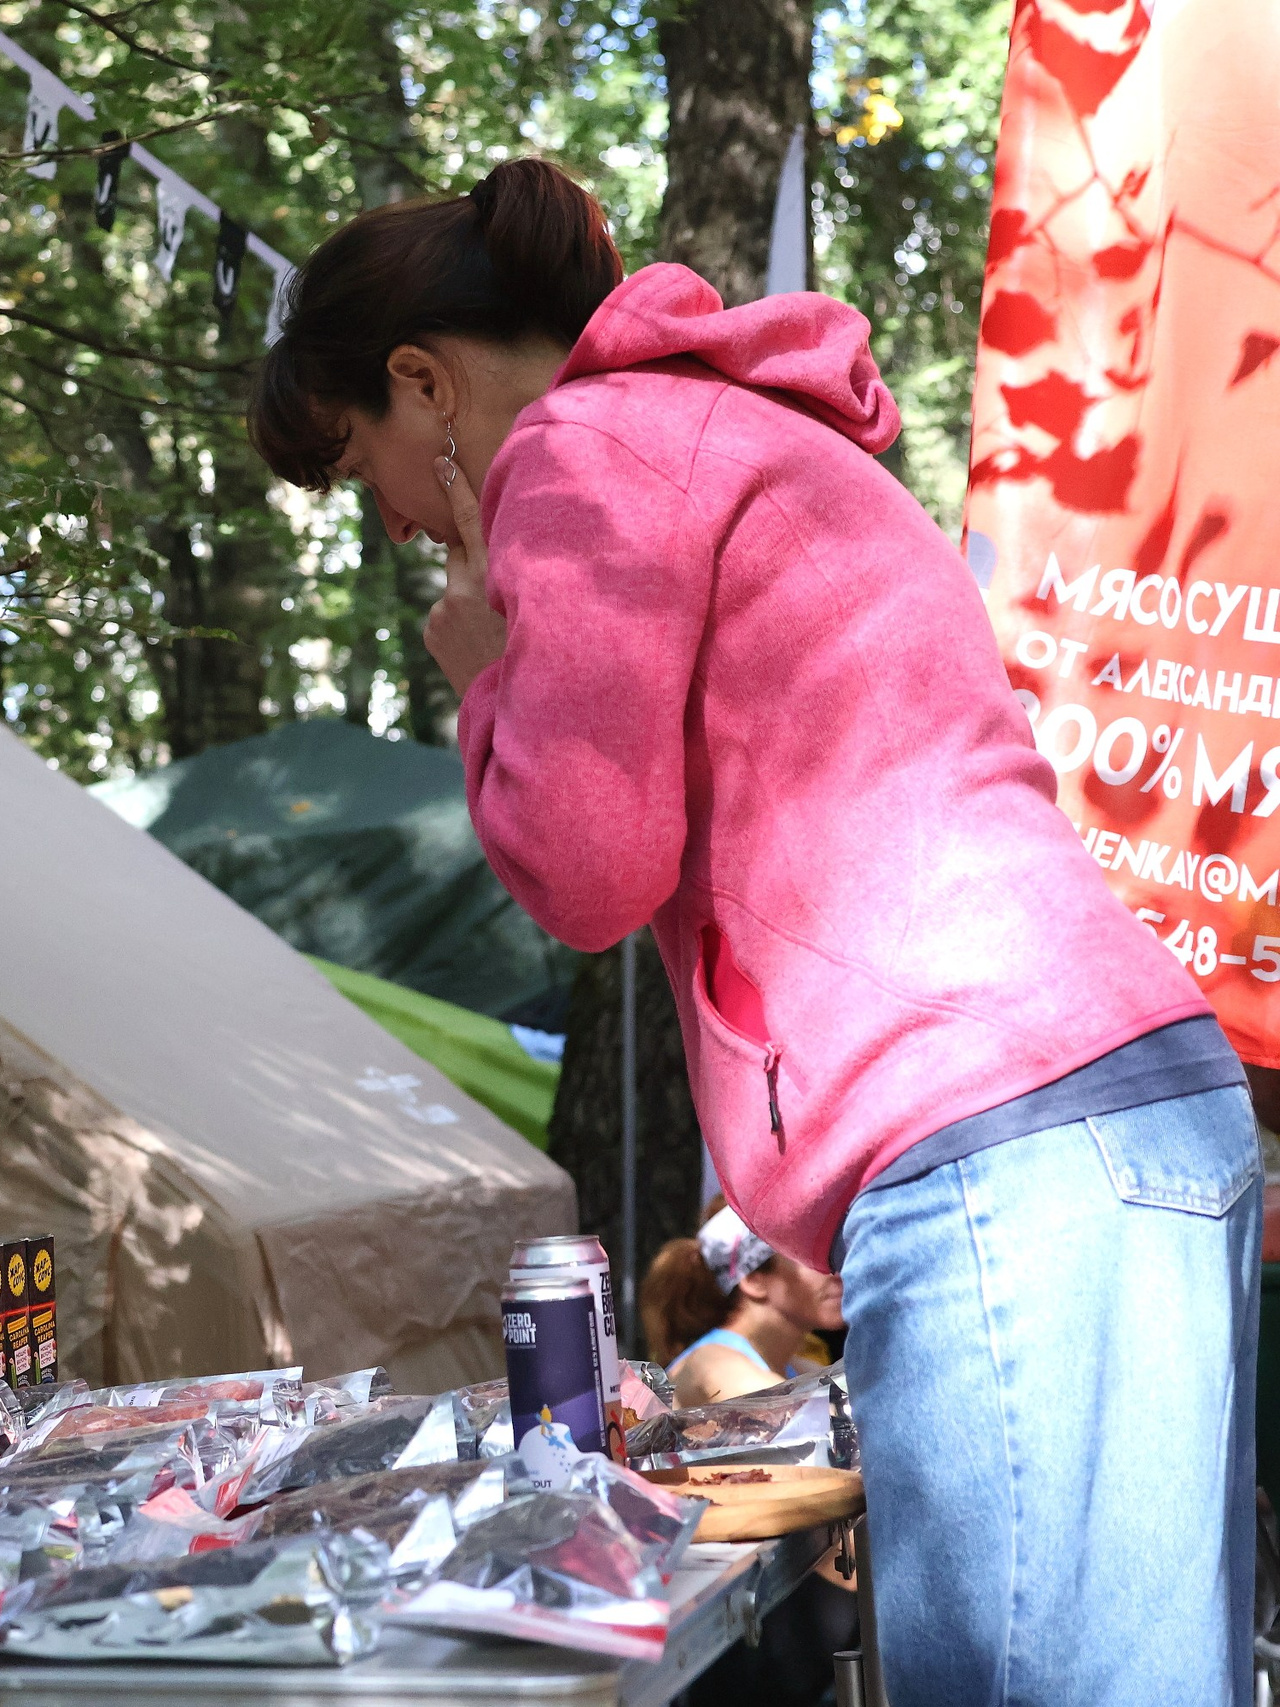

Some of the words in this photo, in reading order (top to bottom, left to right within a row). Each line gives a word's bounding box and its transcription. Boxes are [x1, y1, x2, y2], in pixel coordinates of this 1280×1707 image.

[1015, 631, 1089, 678] ОТ
[1091, 652, 1280, 719] АЛЕКСАНД
[9, 1326, 29, 1341] CAROLINA
[34, 1321, 55, 1336] CAROLINA
[508, 1328, 536, 1343] POINT
[13, 1336, 28, 1349] REAPER
[38, 1330, 53, 1343] REAPER
